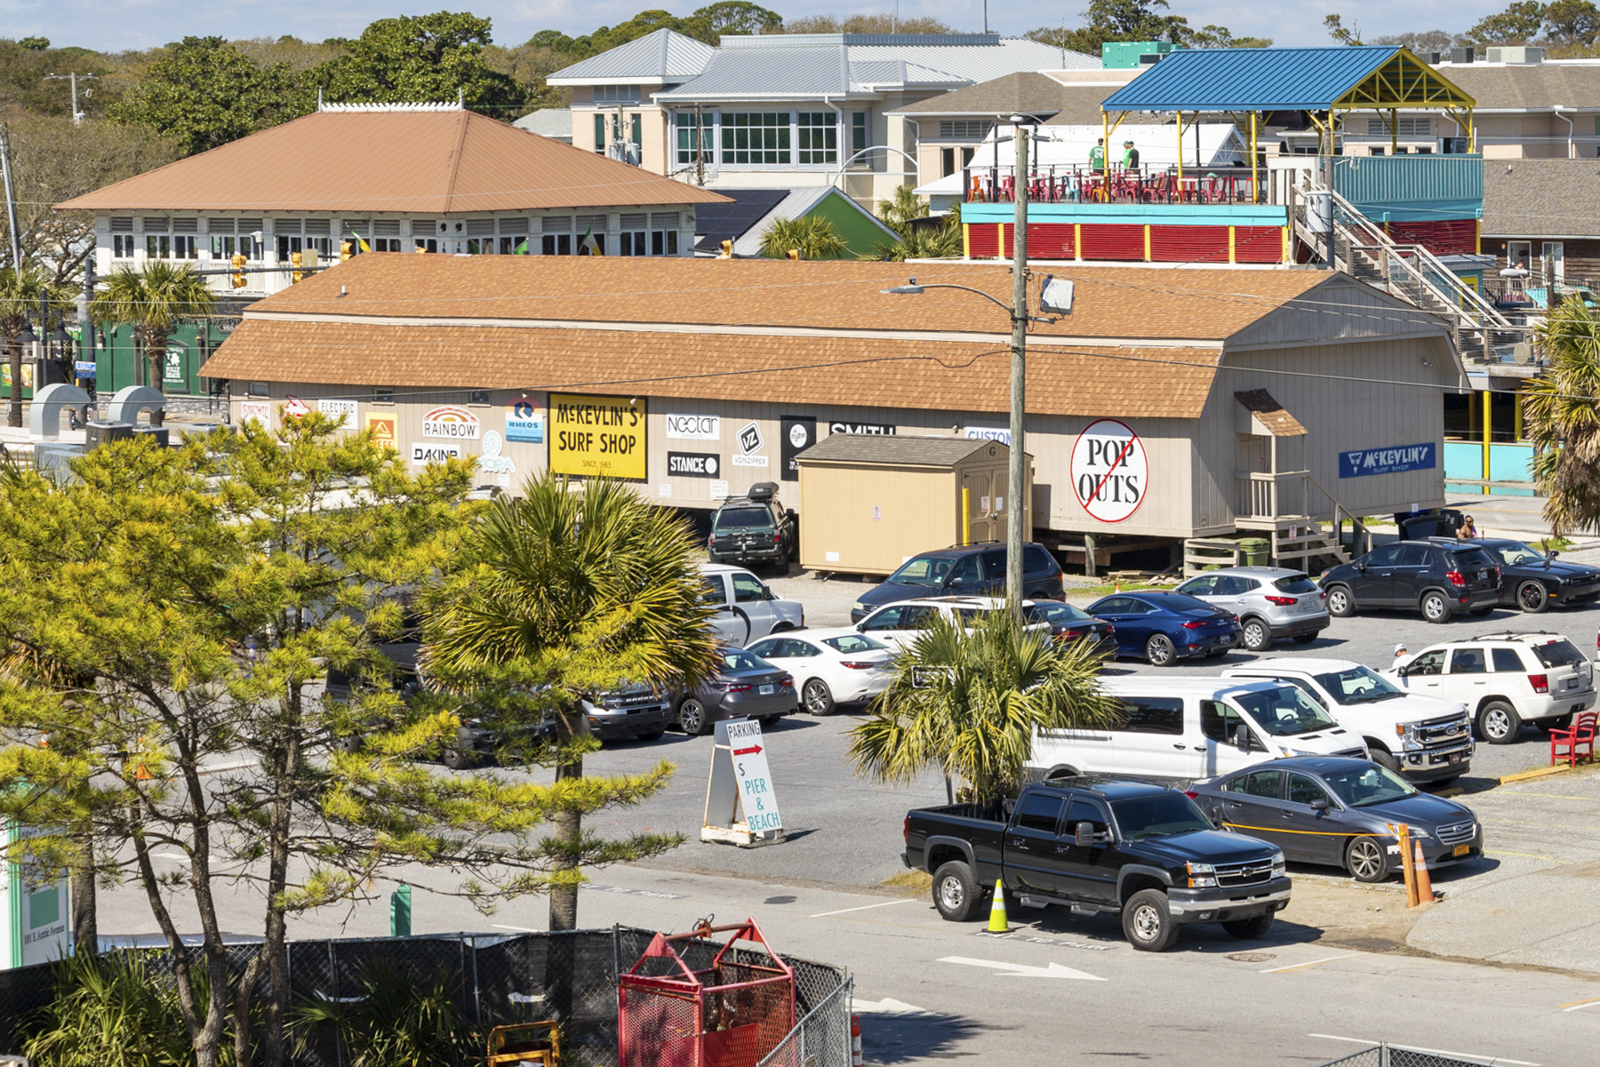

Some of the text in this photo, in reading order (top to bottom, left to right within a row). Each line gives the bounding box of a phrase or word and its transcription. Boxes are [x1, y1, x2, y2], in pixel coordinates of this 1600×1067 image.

[321, 402, 354, 414] ELECTRIC
[424, 423, 476, 436] RAINBOW
[558, 430, 636, 454] SURF SHOP
[989, 446, 996, 456] G
[1086, 438, 1135, 467] POP
[582, 459, 597, 468] SINCE
[670, 456, 705, 473] STANCE
[734, 456, 766, 465] VONZIPPER
[1373, 464, 1410, 474] SURF SHOP
[1078, 473, 1139, 504] OUTS
[727, 721, 760, 739] PARKING
[745, 778, 767, 795] PIER
[756, 797, 764, 811] &
[747, 812, 780, 831] BEACH
